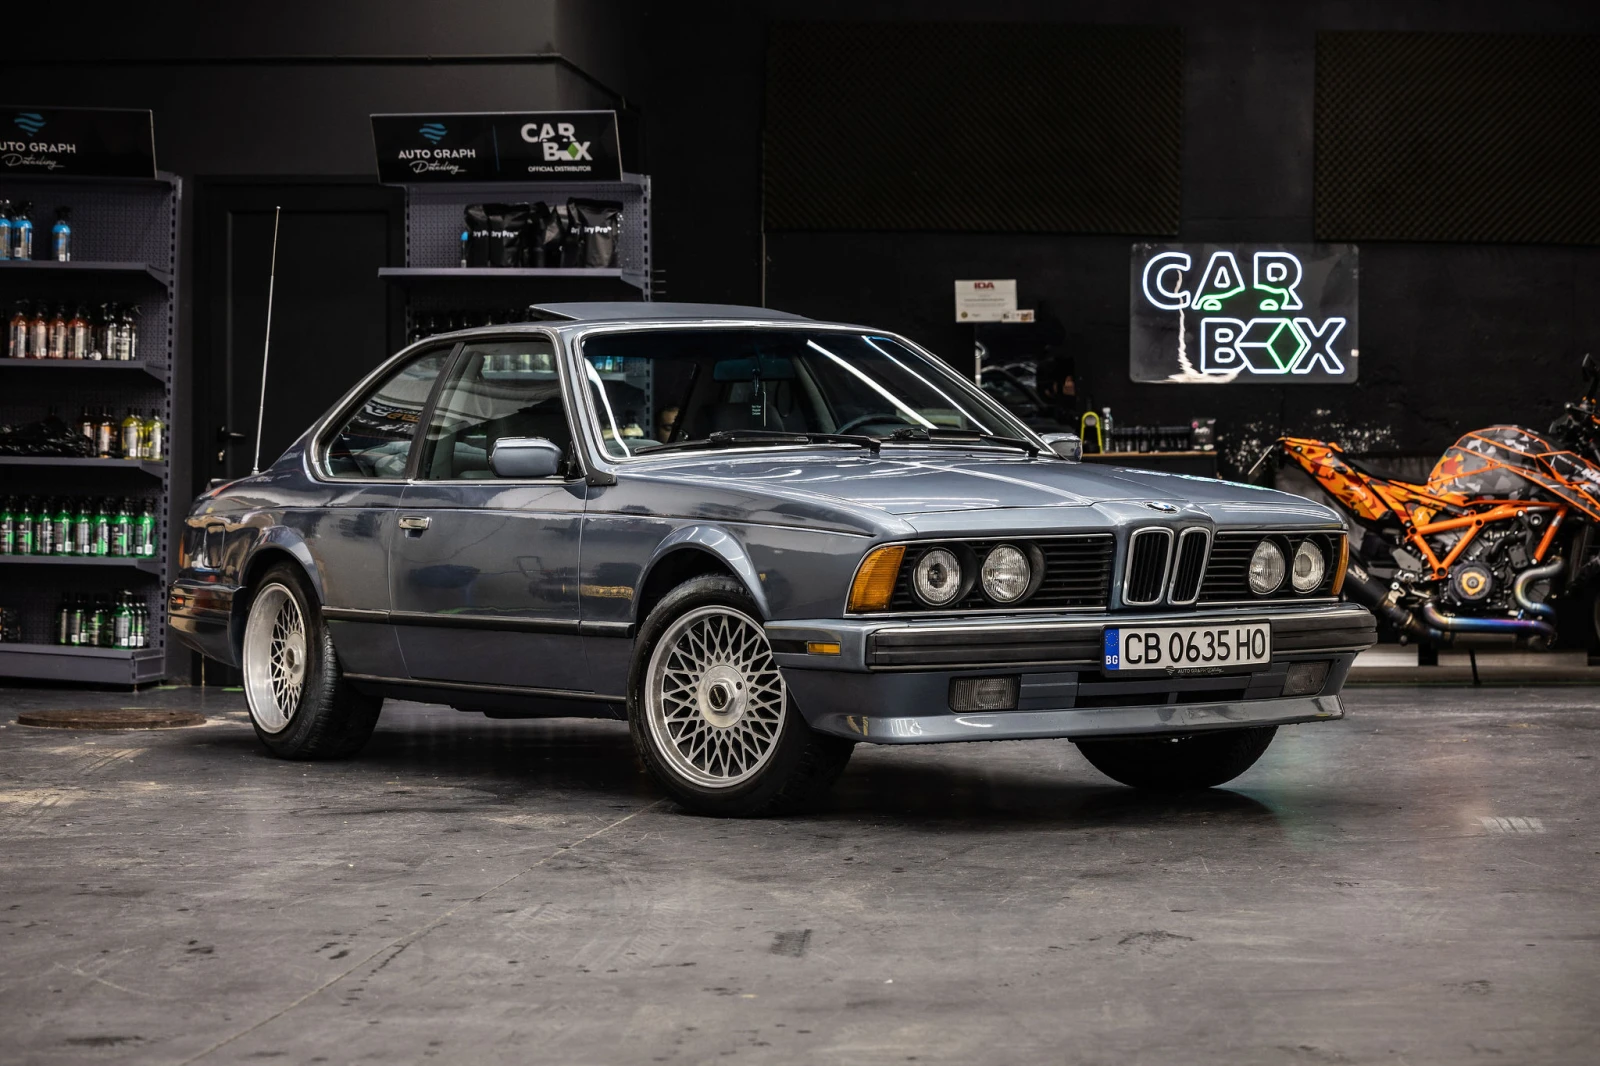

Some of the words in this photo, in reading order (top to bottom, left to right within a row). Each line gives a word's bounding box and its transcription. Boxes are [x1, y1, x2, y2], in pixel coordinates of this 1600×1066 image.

[520, 122, 577, 143] CAR
[0, 141, 26, 151] UTO
[29, 142, 76, 153] GRAPH
[398, 149, 431, 159] AUTO
[433, 149, 476, 159] GRAPH
[1142, 251, 1303, 311] CAR
[1200, 317, 1346, 374] BOX
[1125, 632, 1162, 664] CB
[1169, 629, 1231, 663] 0635
[1105, 655, 1118, 665] BG
